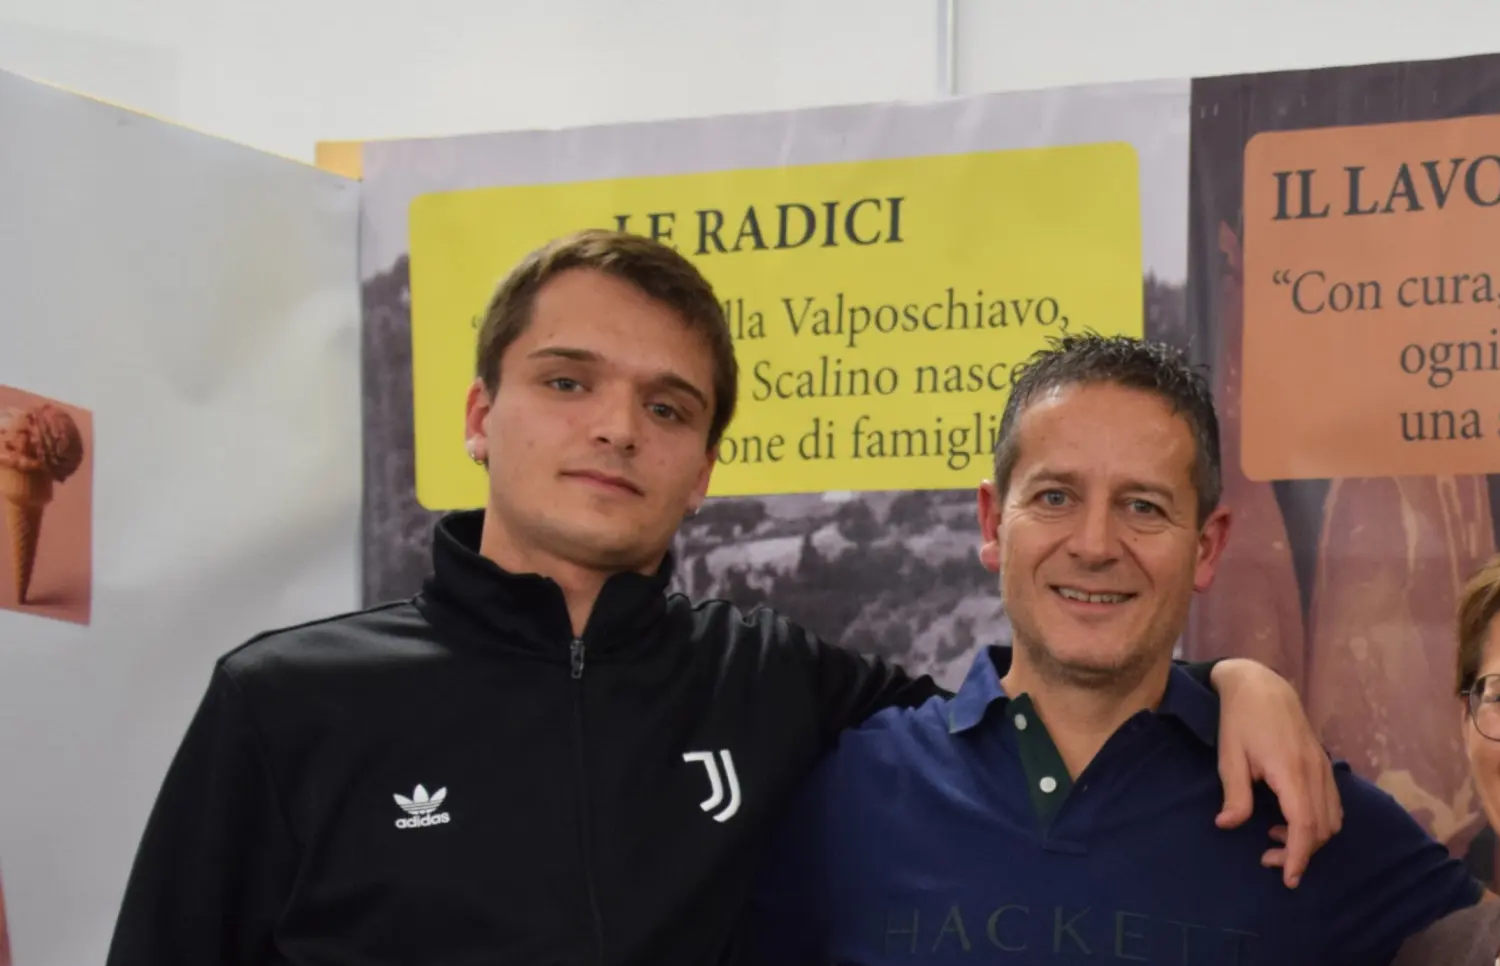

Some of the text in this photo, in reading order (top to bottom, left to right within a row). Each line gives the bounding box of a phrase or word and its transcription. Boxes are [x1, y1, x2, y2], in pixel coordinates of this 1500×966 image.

[1271, 169, 1330, 221] IL
[694, 196, 905, 255] RADICI
[1273, 269, 1382, 315] “Con
[725, 287, 1069, 349] lla Valposchiavo,
[752, 355, 899, 402] Scalino
[1399, 341, 1500, 390] ogni
[716, 411, 997, 471] one di famigli
[1399, 409, 1483, 442] una
[395, 812, 451, 829] adidas
